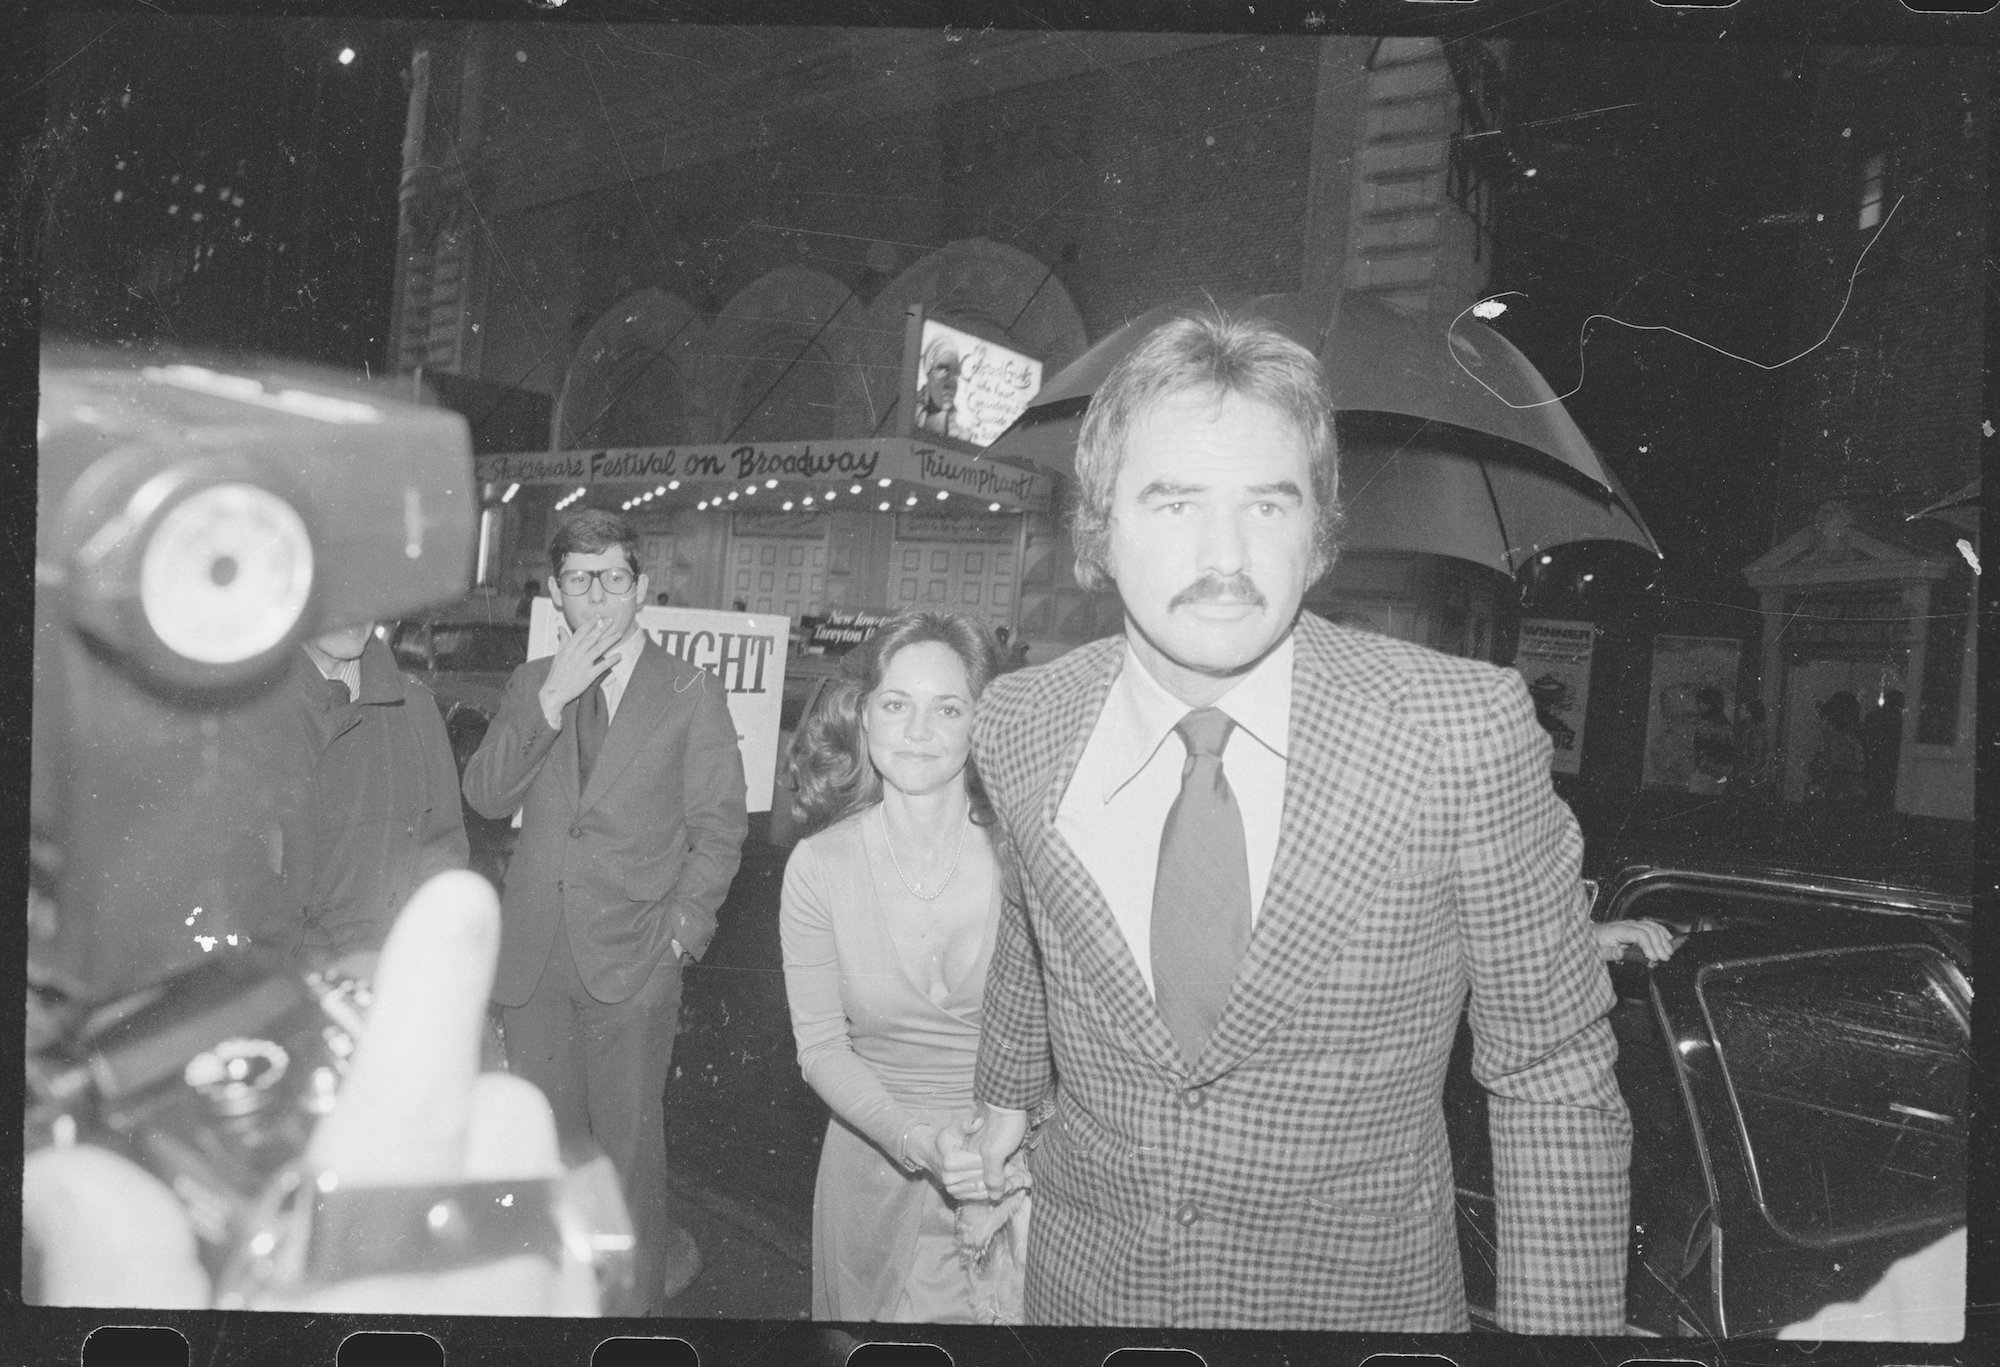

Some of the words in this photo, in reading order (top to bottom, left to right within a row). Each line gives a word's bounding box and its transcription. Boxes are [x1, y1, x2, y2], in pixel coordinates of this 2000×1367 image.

[590, 449, 676, 481] Festival
[684, 452, 726, 476] on
[732, 445, 879, 480] Broadway
[827, 609, 856, 626] New
[813, 624, 863, 644] Tareyton
